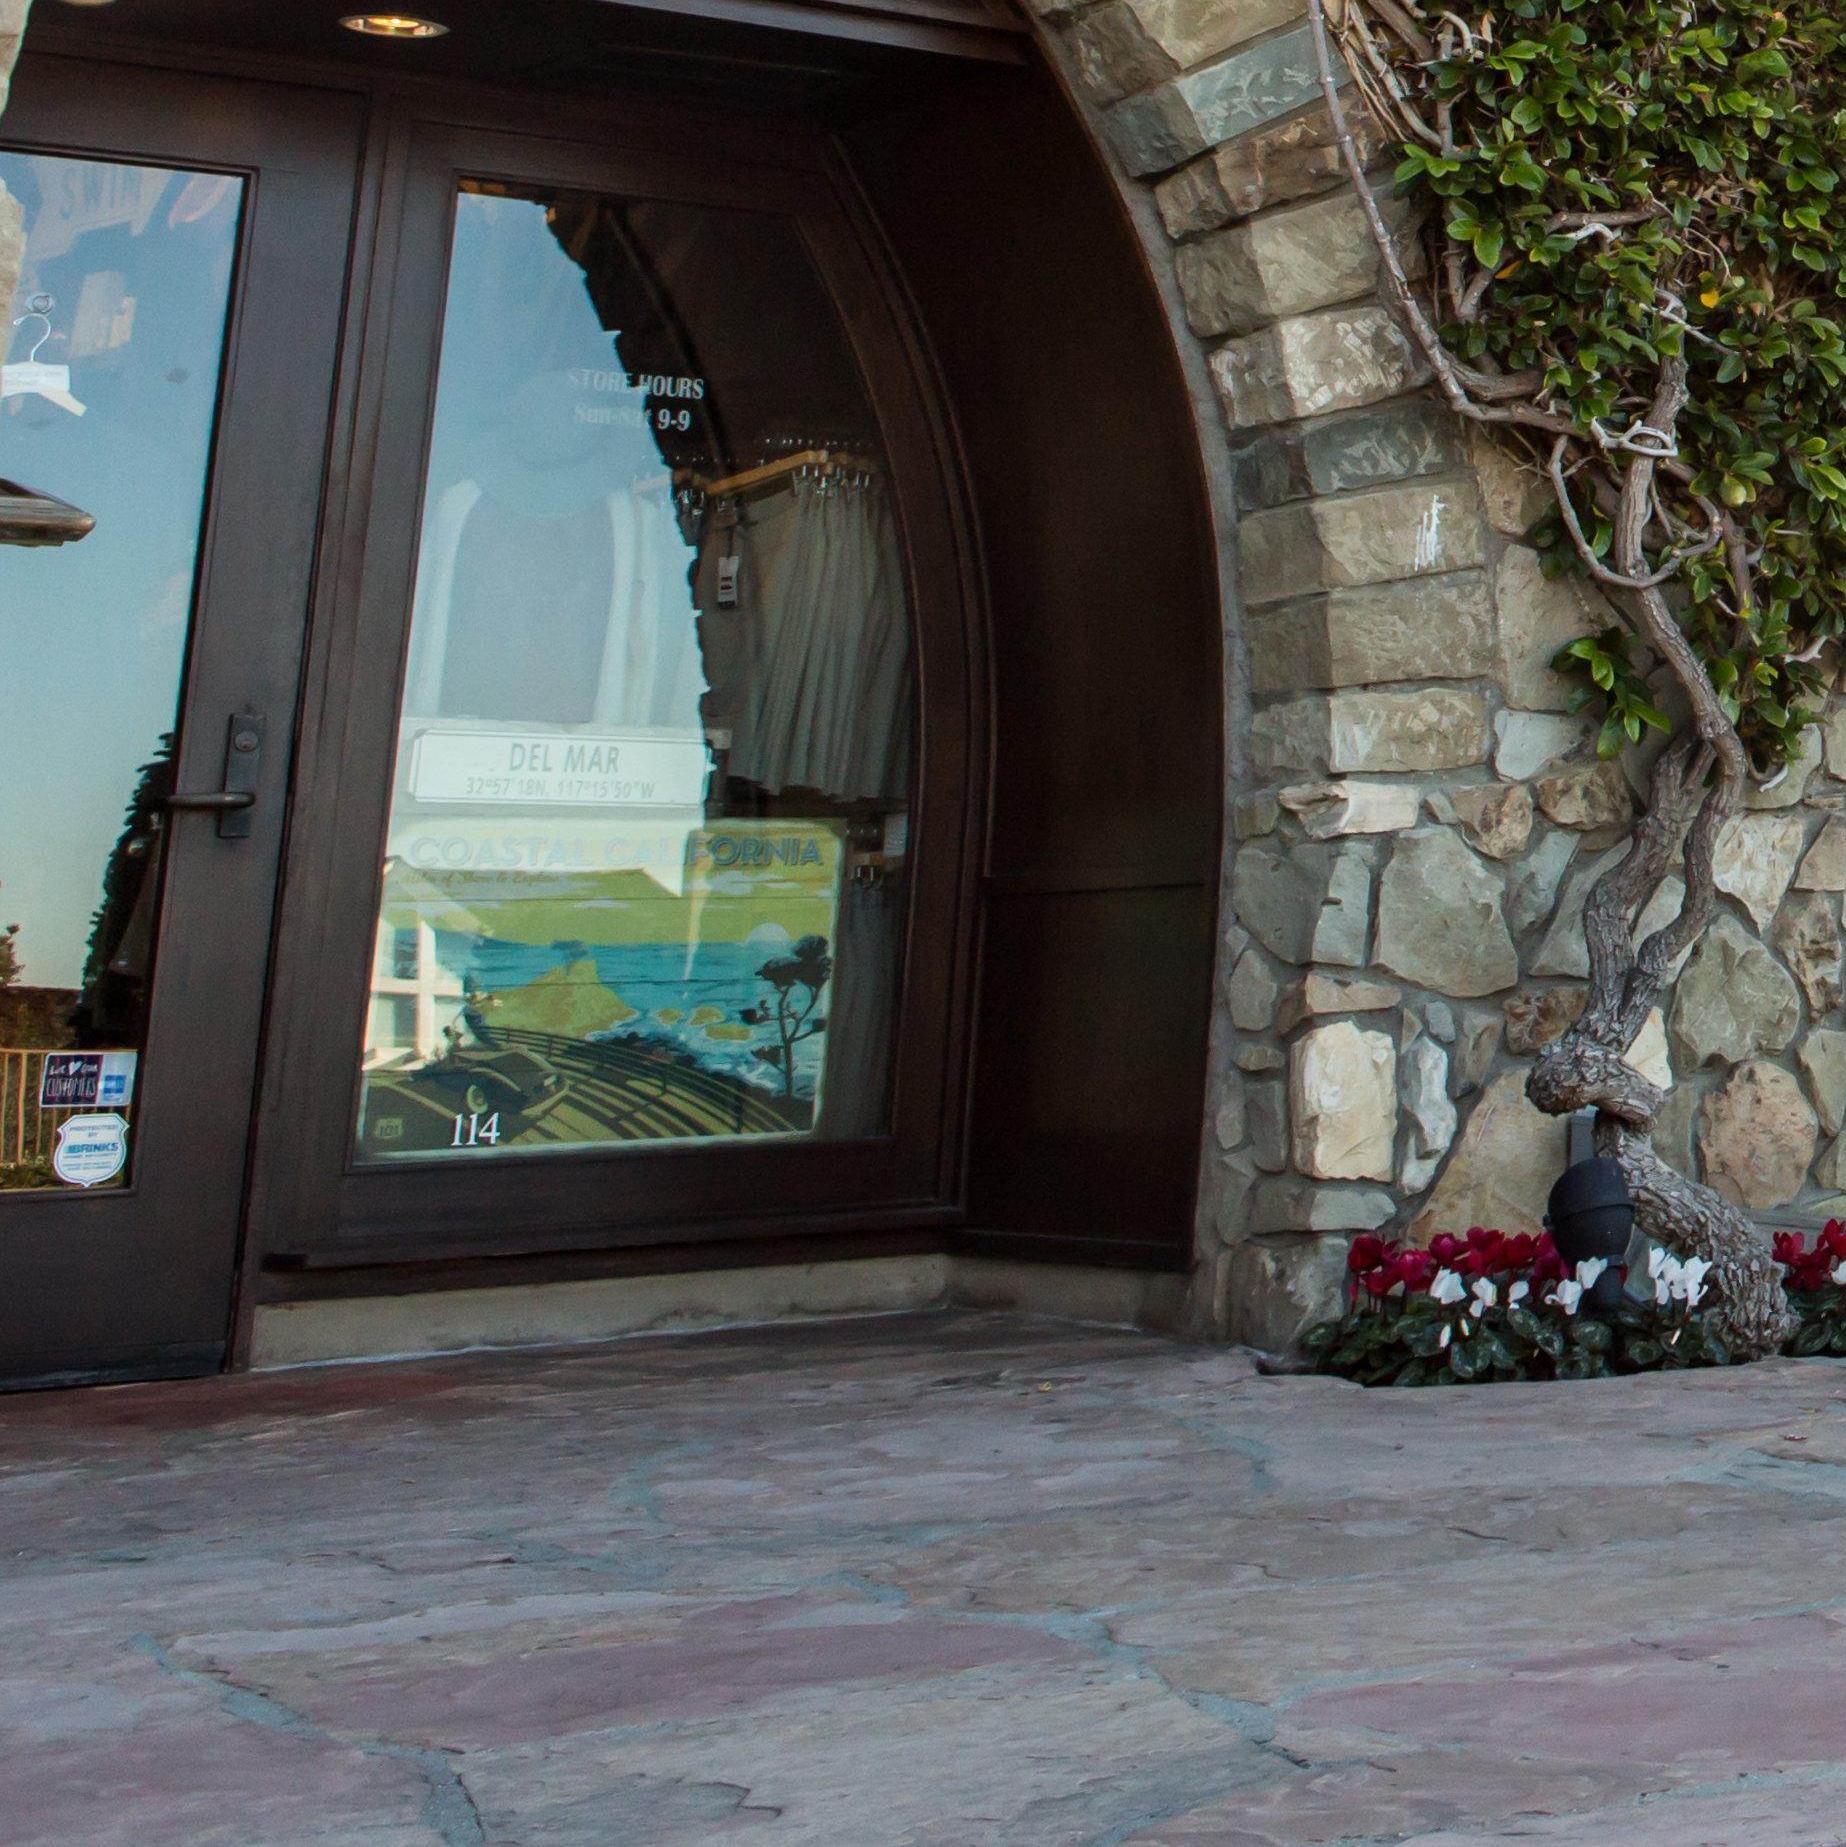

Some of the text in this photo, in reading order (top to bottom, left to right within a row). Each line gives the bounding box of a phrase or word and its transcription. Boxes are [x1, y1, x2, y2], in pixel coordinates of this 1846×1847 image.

[639, 372, 705, 401] HOURS
[658, 408, 692, 433] 9-9
[508, 743, 621, 774] DEL MAR
[410, 836, 825, 868] COASTAL CALIFORNIA
[451, 1112, 501, 1147] 114
